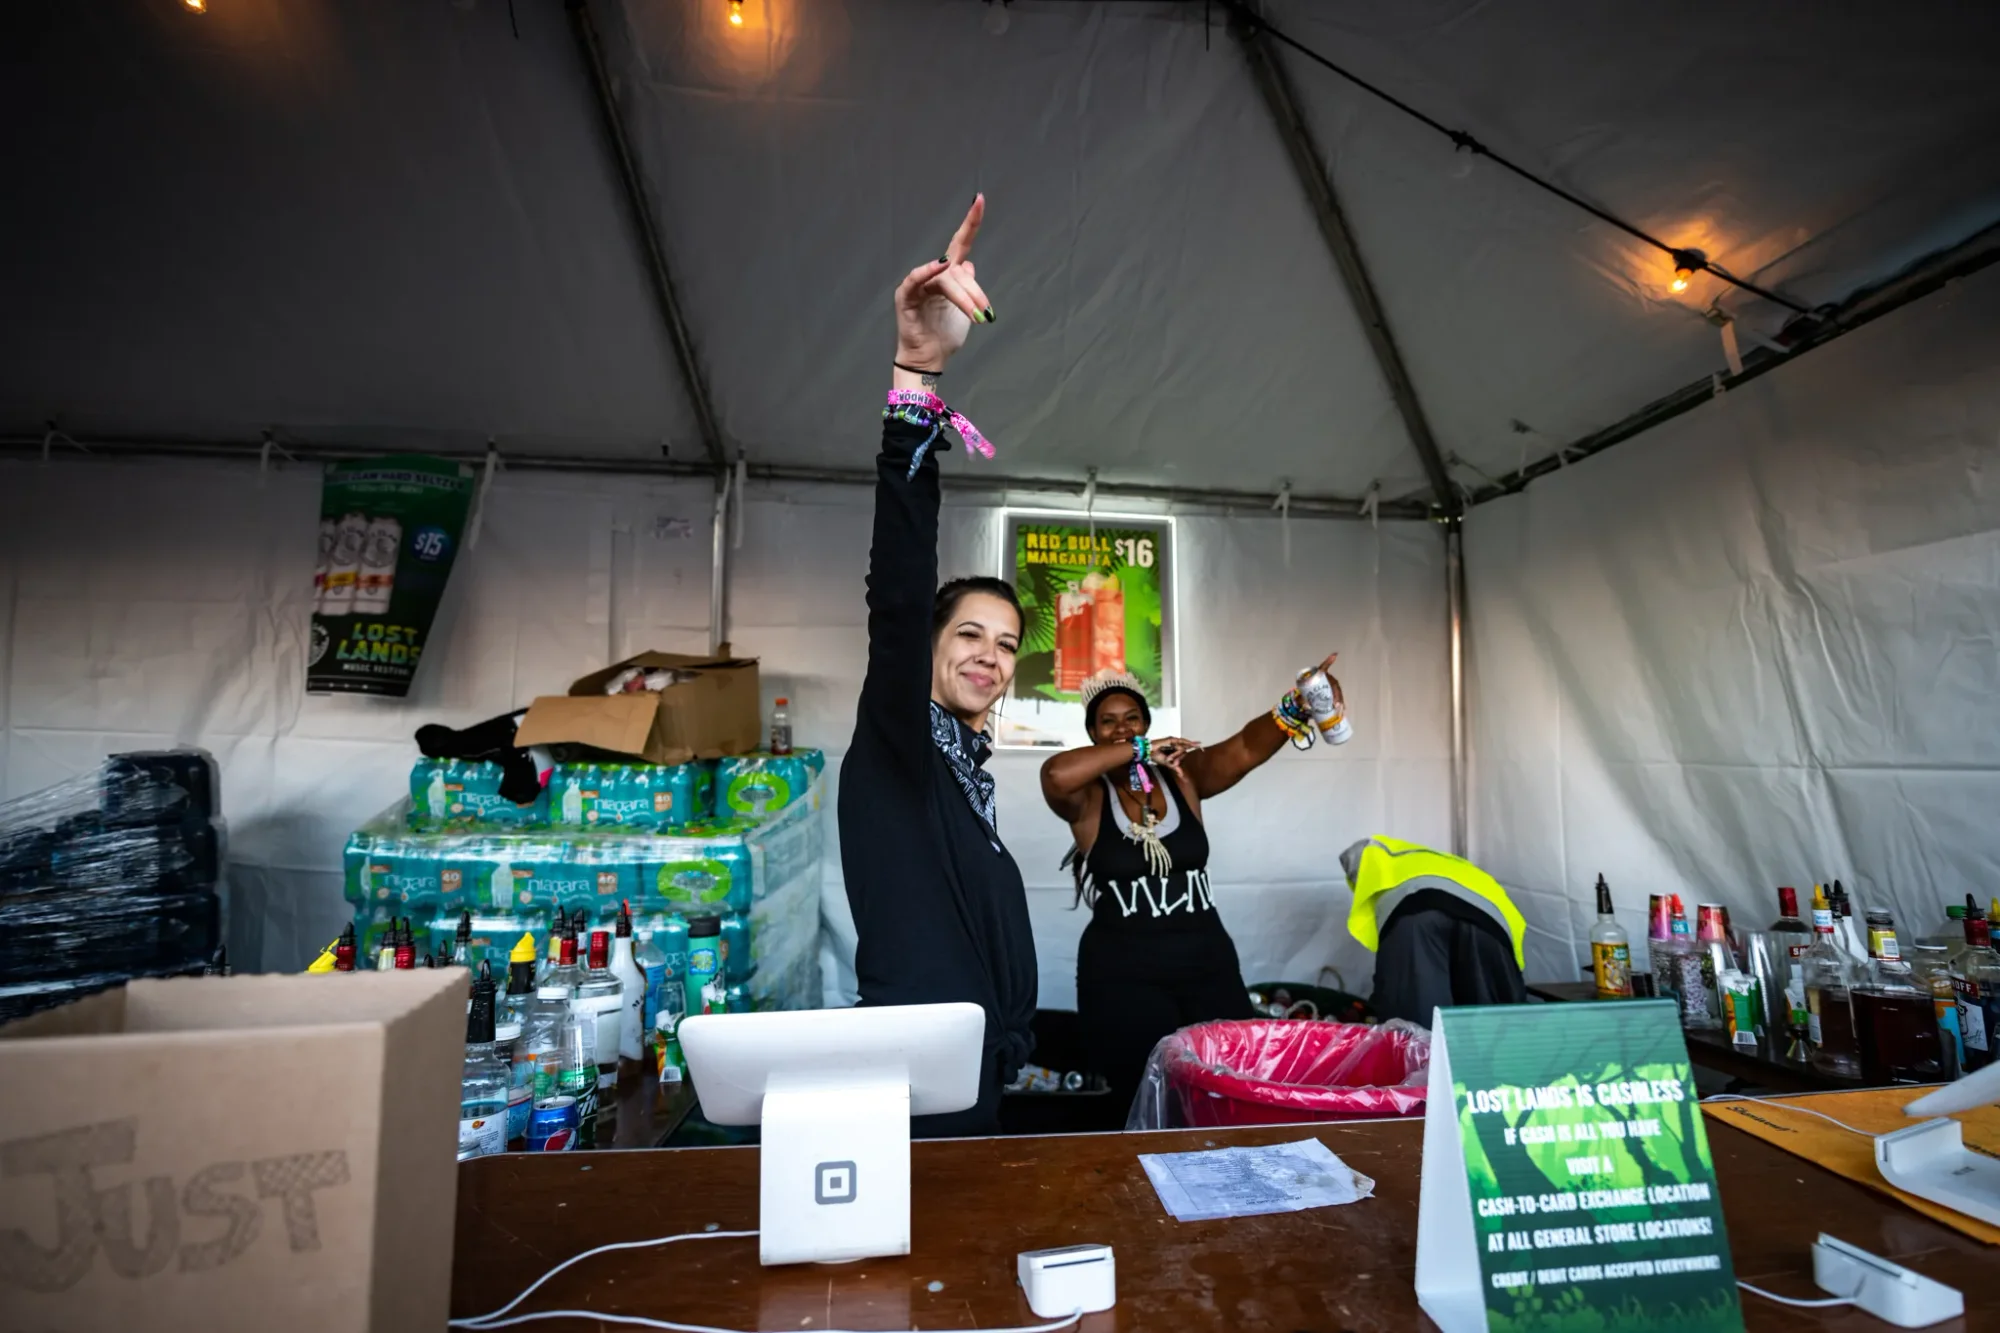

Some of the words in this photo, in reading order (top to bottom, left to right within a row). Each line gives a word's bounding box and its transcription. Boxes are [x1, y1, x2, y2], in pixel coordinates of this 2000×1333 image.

[414, 532, 445, 556] $15
[1027, 532, 1060, 550] RED
[1067, 535, 1111, 552] BULL
[1114, 538, 1154, 568] $16
[1027, 552, 1111, 566] MARGARITA
[352, 622, 418, 646] LOST
[336, 639, 421, 667] LANDS
[594, 797, 649, 815] niagara
[528, 877, 590, 896] niagara
[1466, 1088, 1513, 1114] LOST
[1514, 1086, 1573, 1111] LANDS
[1575, 1084, 1595, 1107] IS
[1596, 1079, 1685, 1106] CASHLESS
[1504, 1128, 1517, 1145] IF
[1519, 1125, 1555, 1145] CASH
[1557, 1124, 1572, 1142] IS
[1574, 1122, 1598, 1141] ALL
[1598, 1121, 1626, 1139] YOU
[1627, 1119, 1662, 1138] HAVE
[1565, 1155, 1601, 1176] VISIT
[1602, 1155, 1614, 1174] A
[1477, 1192, 1577, 1217] CASH-TO-CARD
[1578, 1187, 1647, 1210] EXCHANGE
[1647, 1182, 1711, 1204] LOCATION
[1488, 1233, 1504, 1252] AT
[1507, 1231, 1533, 1250] ALL
[1533, 1226, 1594, 1249] GENERAL
[1594, 1222, 1637, 1244] STORE
[1638, 1216, 1713, 1241] LOCATIONS!
[1491, 1271, 1529, 1288] CREDIT
[1537, 1267, 1567, 1284] DEBIT
[1569, 1265, 1603, 1283] CARDS
[1604, 1261, 1654, 1279] ACCEPTED
